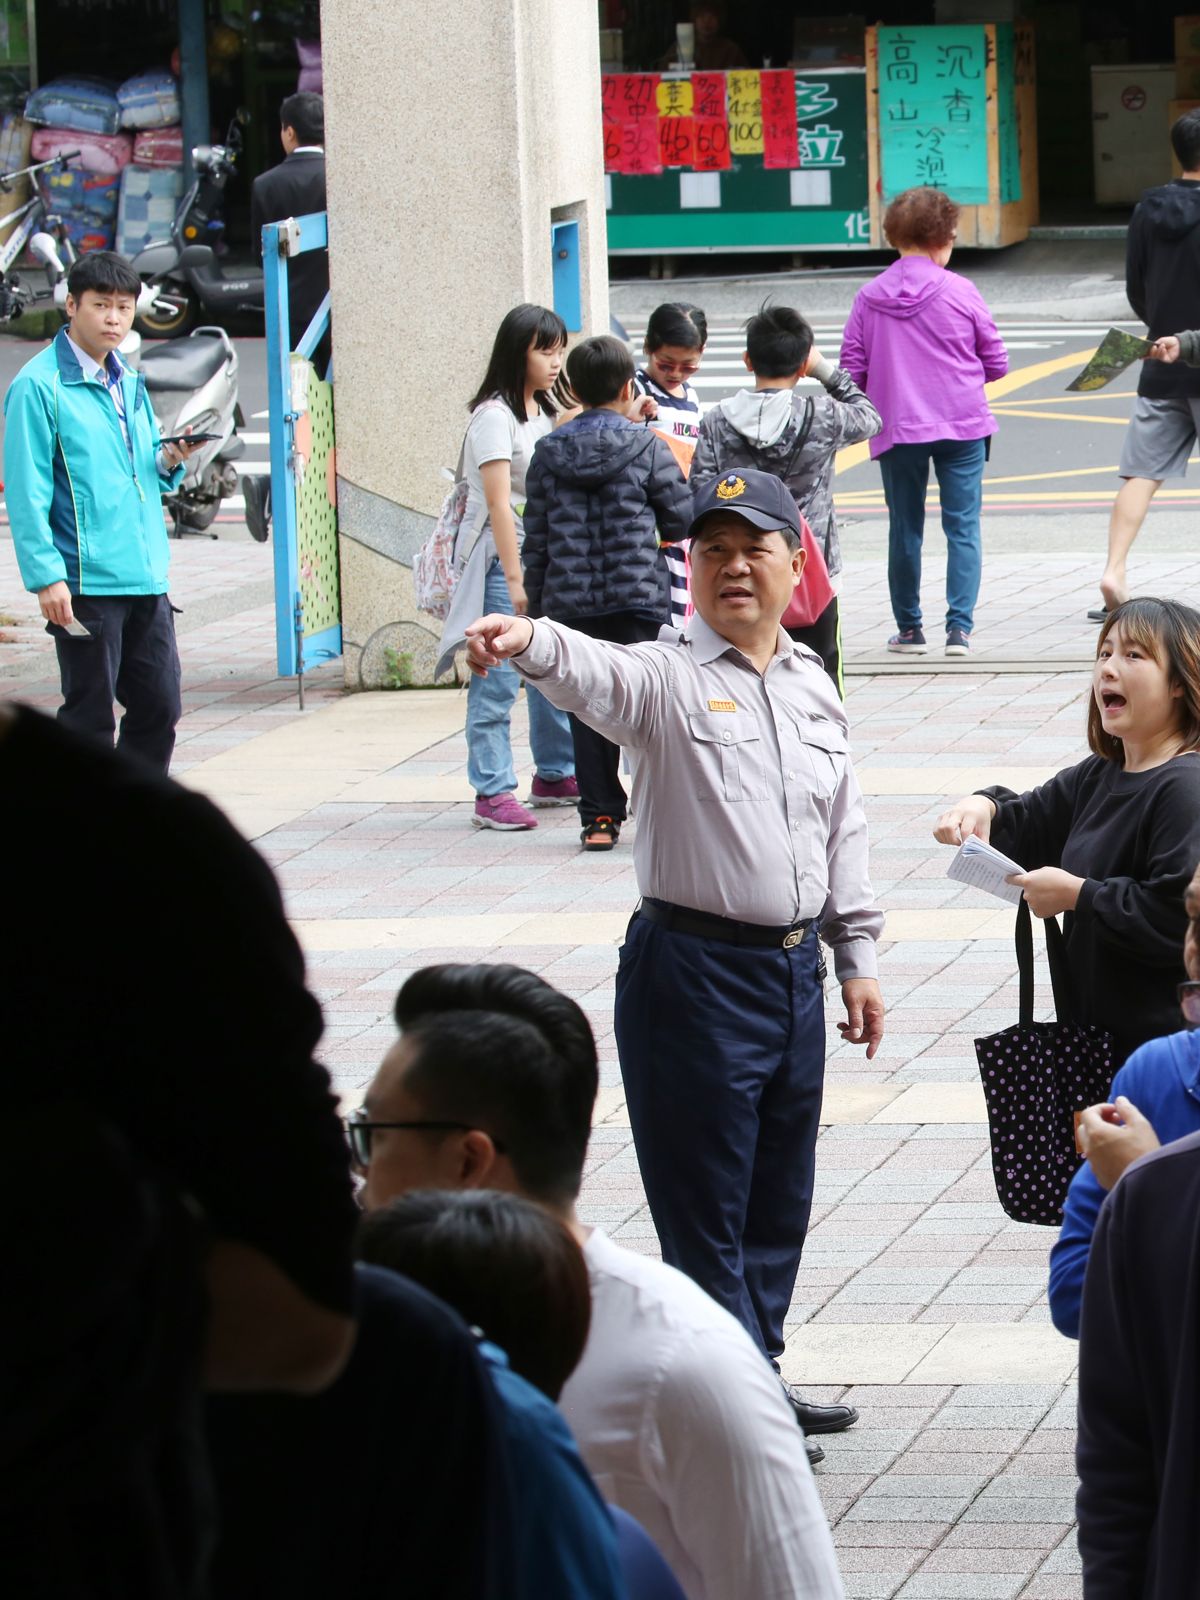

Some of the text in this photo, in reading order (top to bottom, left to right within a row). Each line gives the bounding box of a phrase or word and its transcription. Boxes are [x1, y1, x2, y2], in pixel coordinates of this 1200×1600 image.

[886, 33, 918, 121] 高山
[936, 44, 981, 123] 沉香
[660, 118, 690, 152] 46
[697, 122, 728, 154] 60
[734, 121, 764, 142] 100
[915, 127, 947, 189] 冷泡
